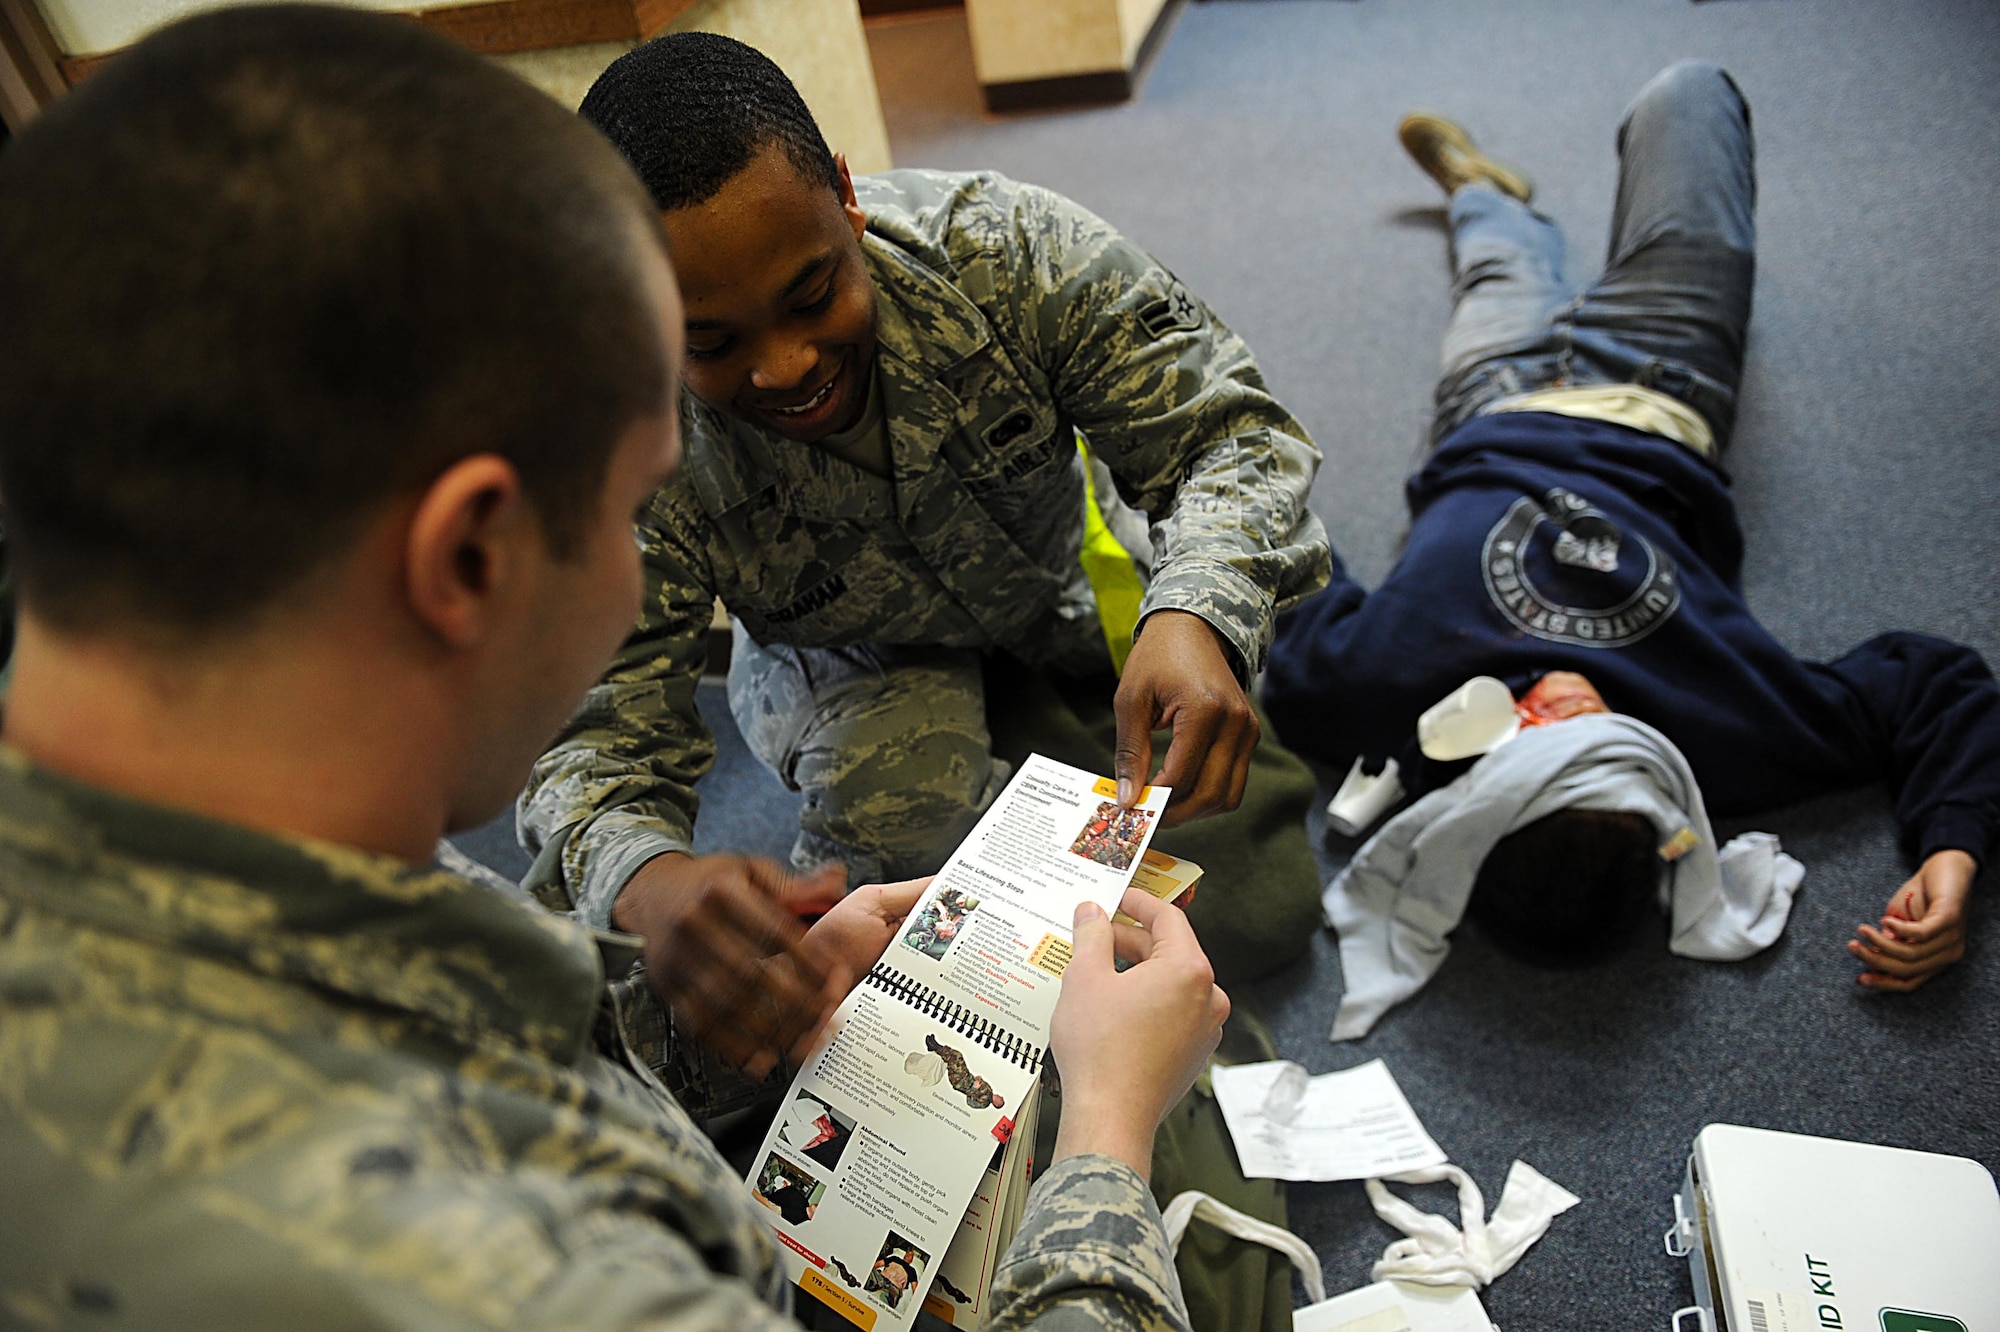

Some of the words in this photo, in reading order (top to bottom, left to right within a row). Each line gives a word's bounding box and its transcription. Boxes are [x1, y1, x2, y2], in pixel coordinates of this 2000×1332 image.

[1574, 588, 1670, 640] UNITED
[957, 859, 974, 871] Basic
[974, 867, 1006, 886] Lifesaving
[1006, 882, 1024, 894] Steps
[1045, 949, 1070, 964] Circulatio
[860, 1125, 888, 1144] Abdominal
[888, 1142, 906, 1156] Wound
[1805, 1254, 1836, 1297] KIT
